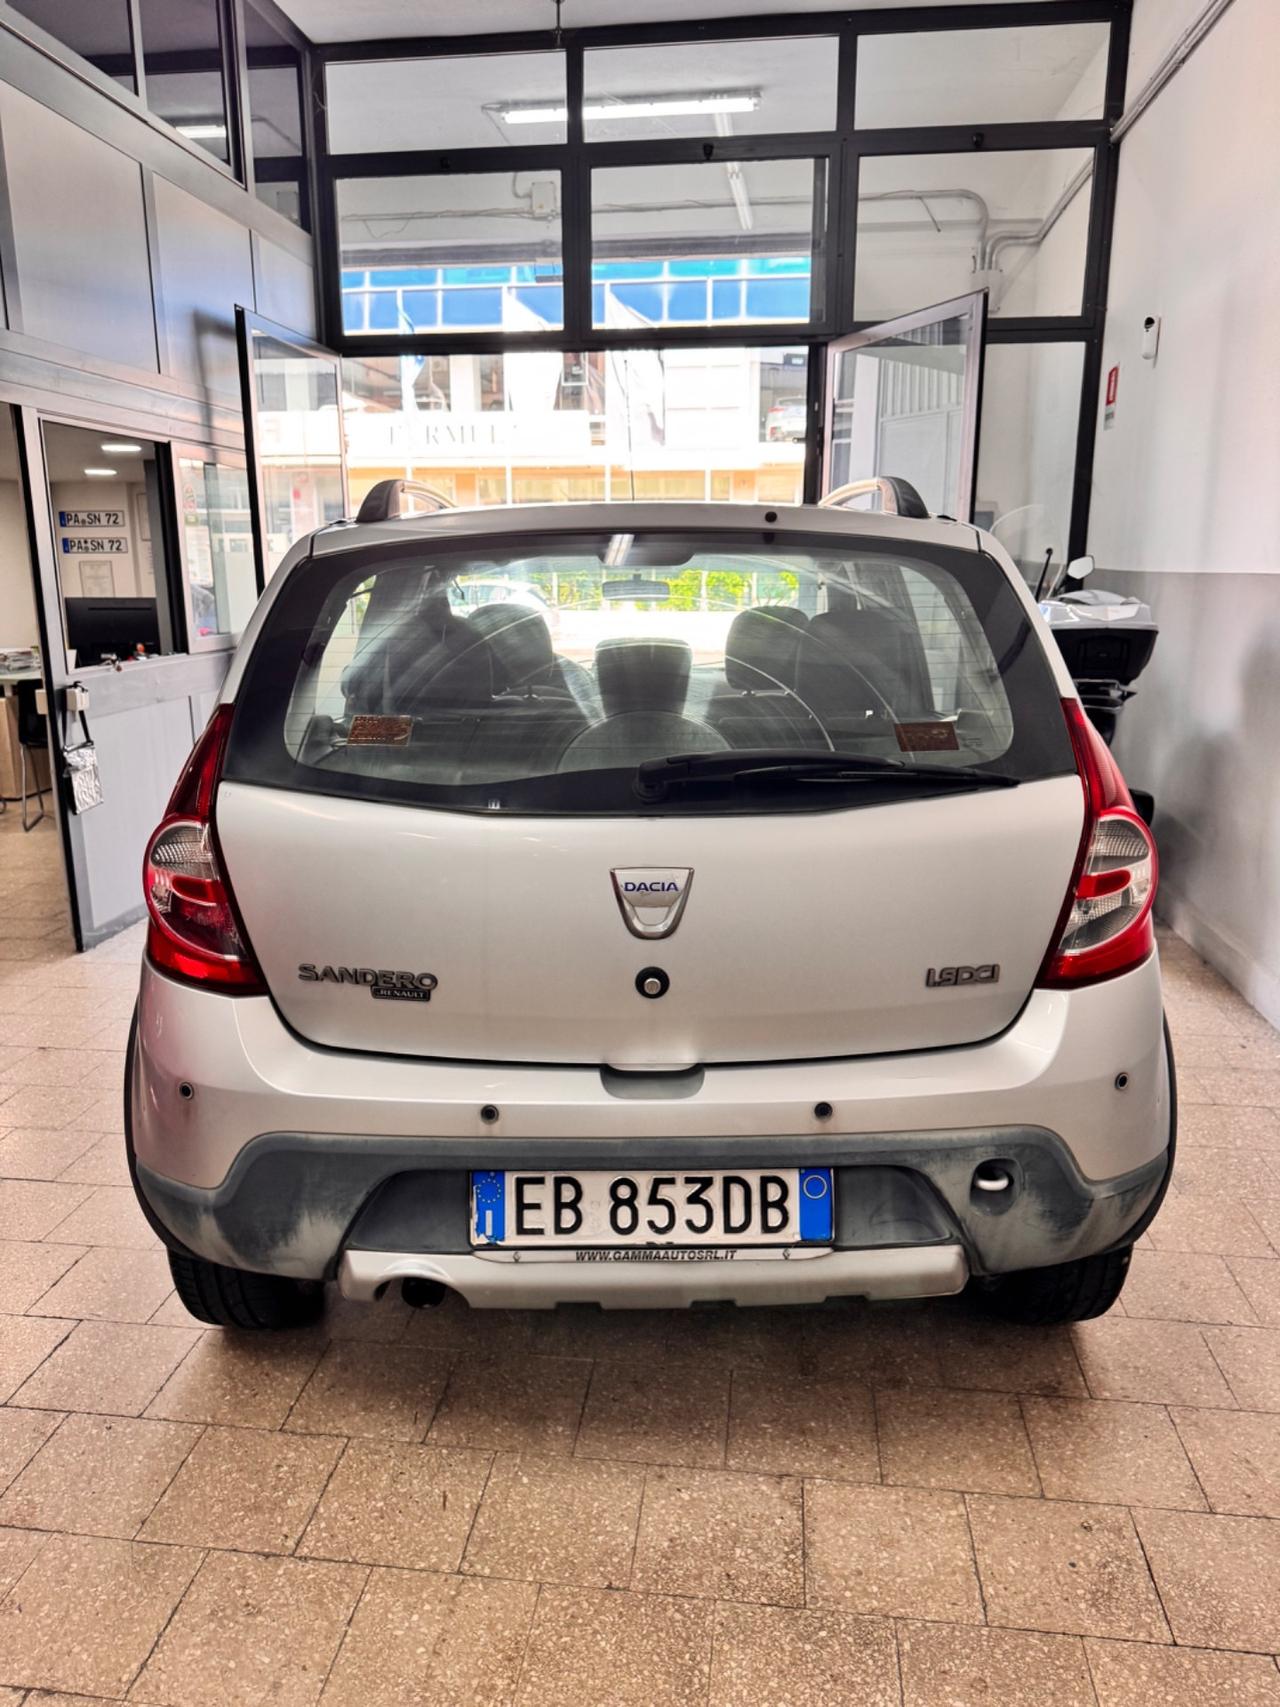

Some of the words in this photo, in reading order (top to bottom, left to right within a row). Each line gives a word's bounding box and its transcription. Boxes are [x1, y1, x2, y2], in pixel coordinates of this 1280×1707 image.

[66, 513, 80, 524] PA
[86, 513, 101, 525] SN
[105, 513, 120, 524] 72
[70, 540, 83, 551] PA
[90, 540, 104, 551] SN
[108, 540, 122, 551] 72
[624, 882, 679, 892] DACIA
[298, 963, 438, 991] SANDERO
[380, 989, 425, 998] RENAULT
[515, 1176, 583, 1235] EB
[609, 1175, 789, 1235] 853DB
[576, 1250, 737, 1261] WWW.GAMMAAUTOSRL.IT
